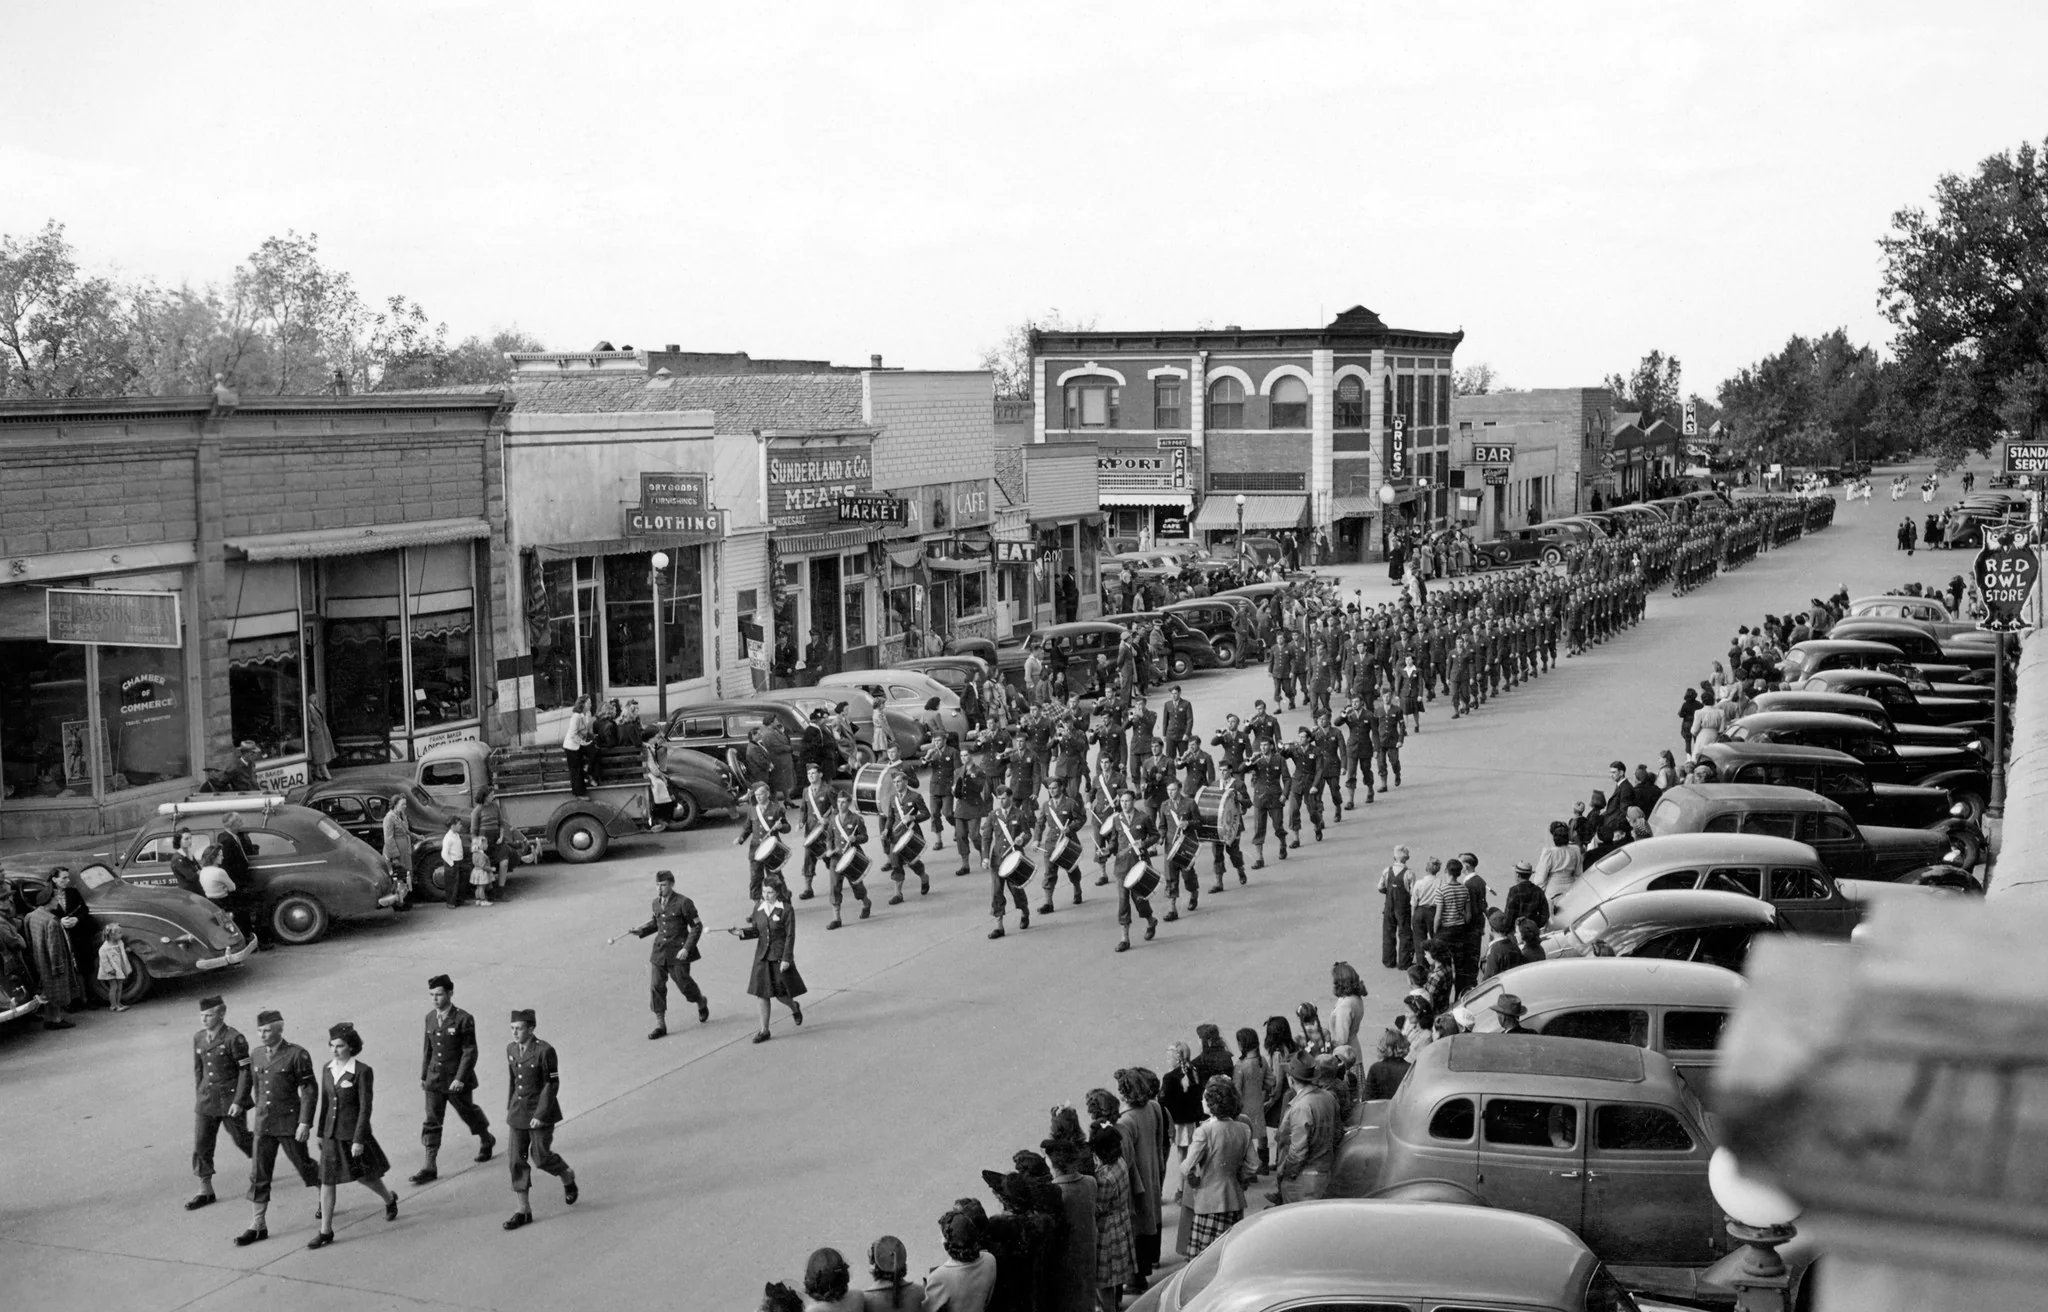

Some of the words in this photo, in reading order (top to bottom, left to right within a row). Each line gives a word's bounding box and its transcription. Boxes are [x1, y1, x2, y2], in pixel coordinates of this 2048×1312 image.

[1686, 404, 1694, 431] GAS
[1393, 420, 1403, 472] DRUGS
[1476, 447, 1511, 461] BAR
[771, 458, 843, 484] SUNDERLAND
[845, 460, 853, 479] &
[1174, 449, 1183, 487] CAFE
[649, 484, 667, 492] DRY
[668, 483, 699, 492] GOODS
[957, 491, 986, 513] CAFE
[841, 504, 900, 520] MARKET
[633, 516, 717, 530] CLOTHING
[998, 543, 1036, 561] EAT
[1985, 559, 2030, 572] RED
[1984, 573, 2026, 588] OWL
[1986, 589, 2024, 602] STORE
[74, 606, 132, 623] PASSION
[140, 608, 176, 625] PLAY
[122, 674, 166, 690] CHAMBER
[141, 689, 150, 697] OF
[120, 698, 173, 713] COMMERCE
[429, 734, 446, 744] FRANK
[446, 730, 462, 740] BAKER
[265, 768, 284, 778] BAKER
[270, 772, 305, 791] WEAR
